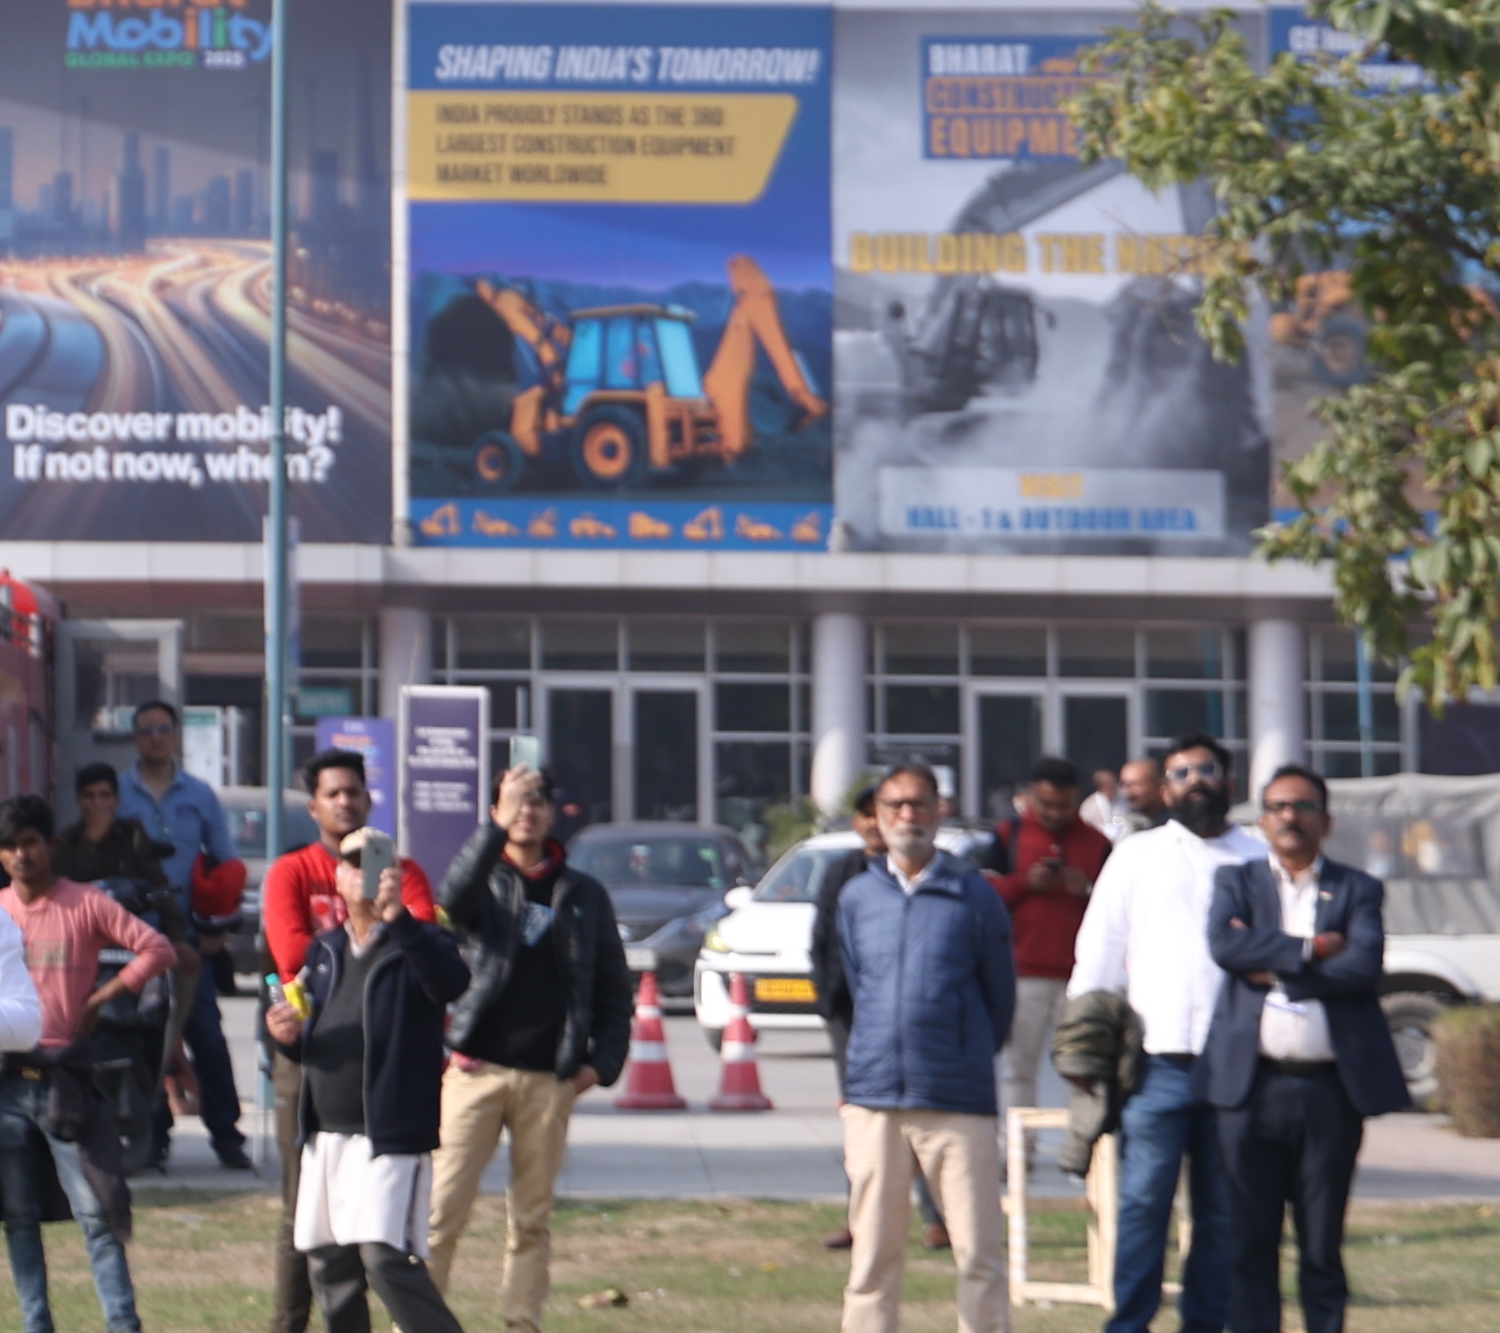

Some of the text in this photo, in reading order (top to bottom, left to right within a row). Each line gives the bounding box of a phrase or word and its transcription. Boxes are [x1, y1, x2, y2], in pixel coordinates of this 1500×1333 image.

[65, 6, 272, 61] Mobility
[435, 43, 820, 83] SHAPING INDIA'S TOMORROW!
[928, 43, 1030, 75] BHARAT
[435, 103, 481, 124] INDIA
[484, 104, 556, 124] PROUDLY
[562, 105, 626, 125] STANDS
[629, 106, 651, 126] AS
[655, 106, 687, 126] THE
[435, 132, 735, 157] LARGEST CONSTRUCTION EQUIPMENT
[931, 118, 1080, 156] EQUIPME
[435, 163, 610, 186] MARKET WORLDWIDE
[849, 232, 1027, 274] BUILDING
[1036, 234, 1107, 274] THE
[5, 403, 343, 446] Discover mobiity!
[13, 443, 43, 481] If
[44, 446, 109, 481] not
[111, 449, 204, 489] now,
